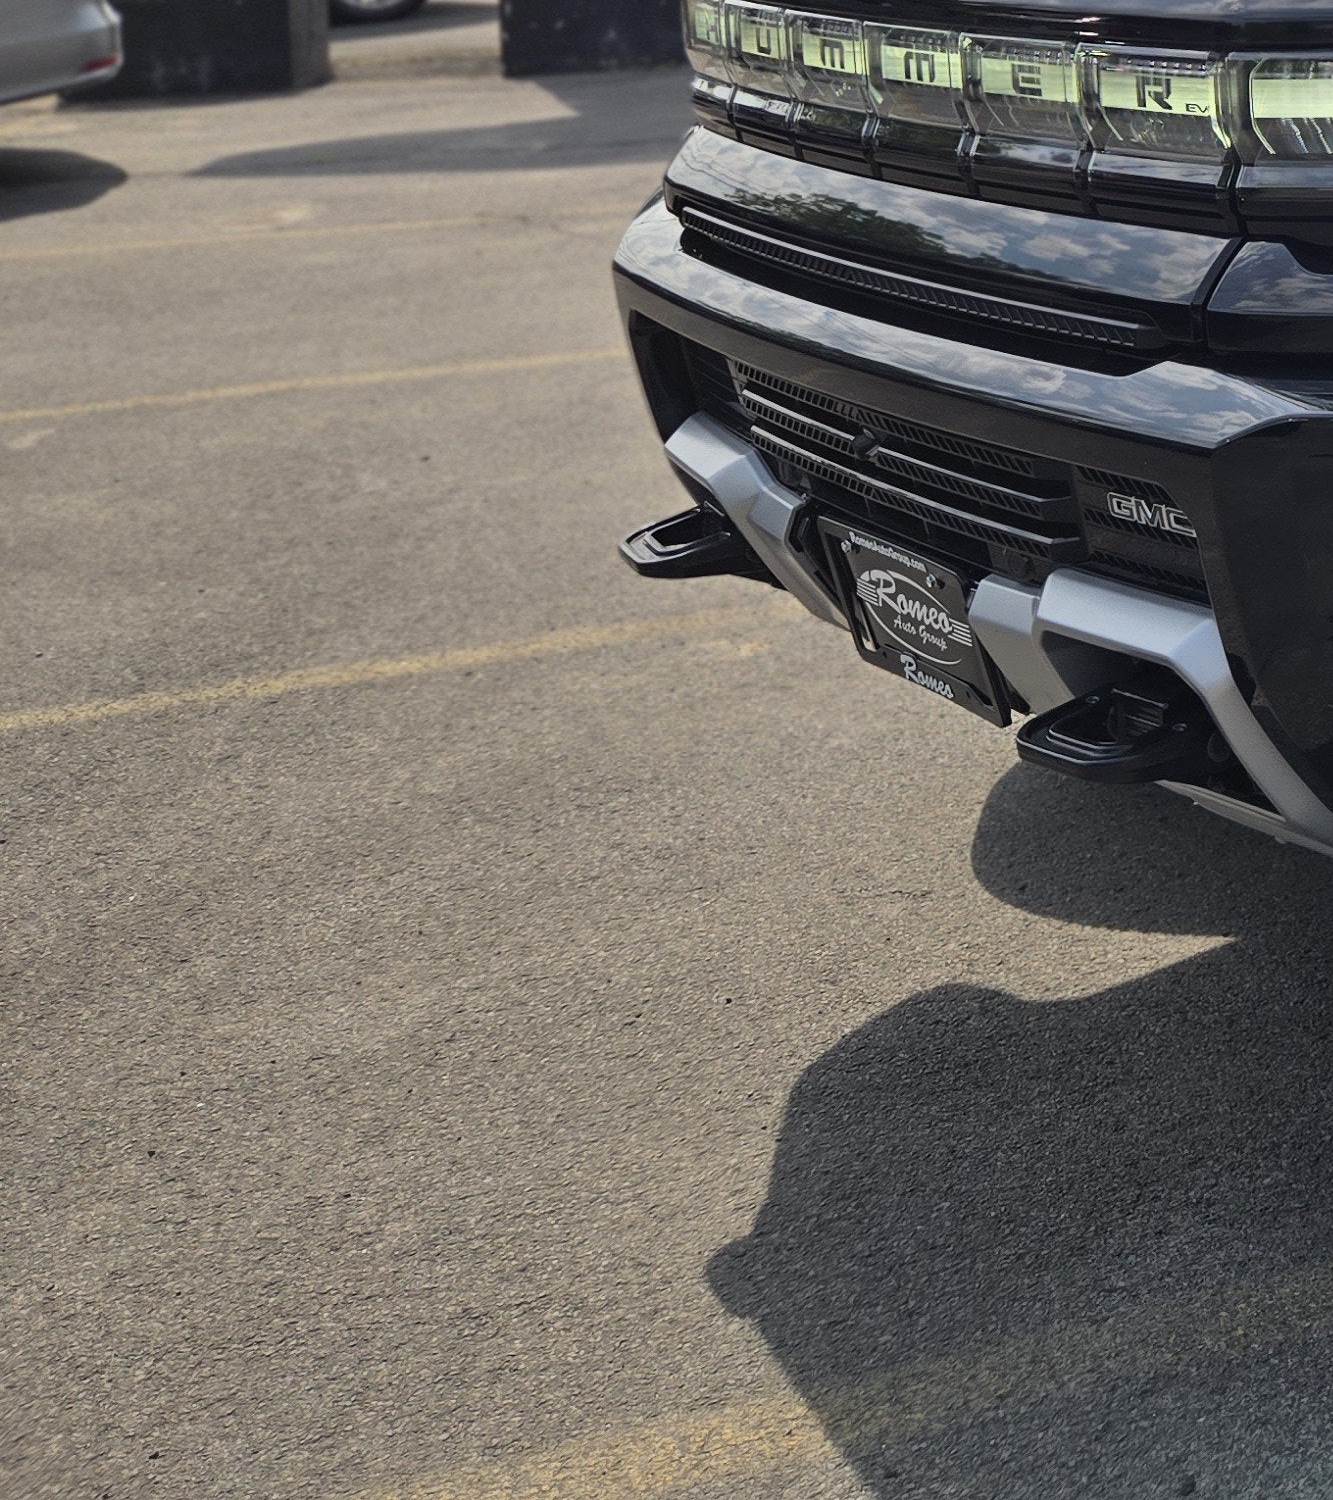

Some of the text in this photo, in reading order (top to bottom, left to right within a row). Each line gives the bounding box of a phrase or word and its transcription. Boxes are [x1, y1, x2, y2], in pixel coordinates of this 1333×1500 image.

[703, 10, 1210, 114] HUMMER EV
[1106, 491, 1198, 538] GMC
[868, 568, 953, 634] Romeo
[893, 614, 948, 652] Auto Group
[900, 654, 954, 699] Romeo
